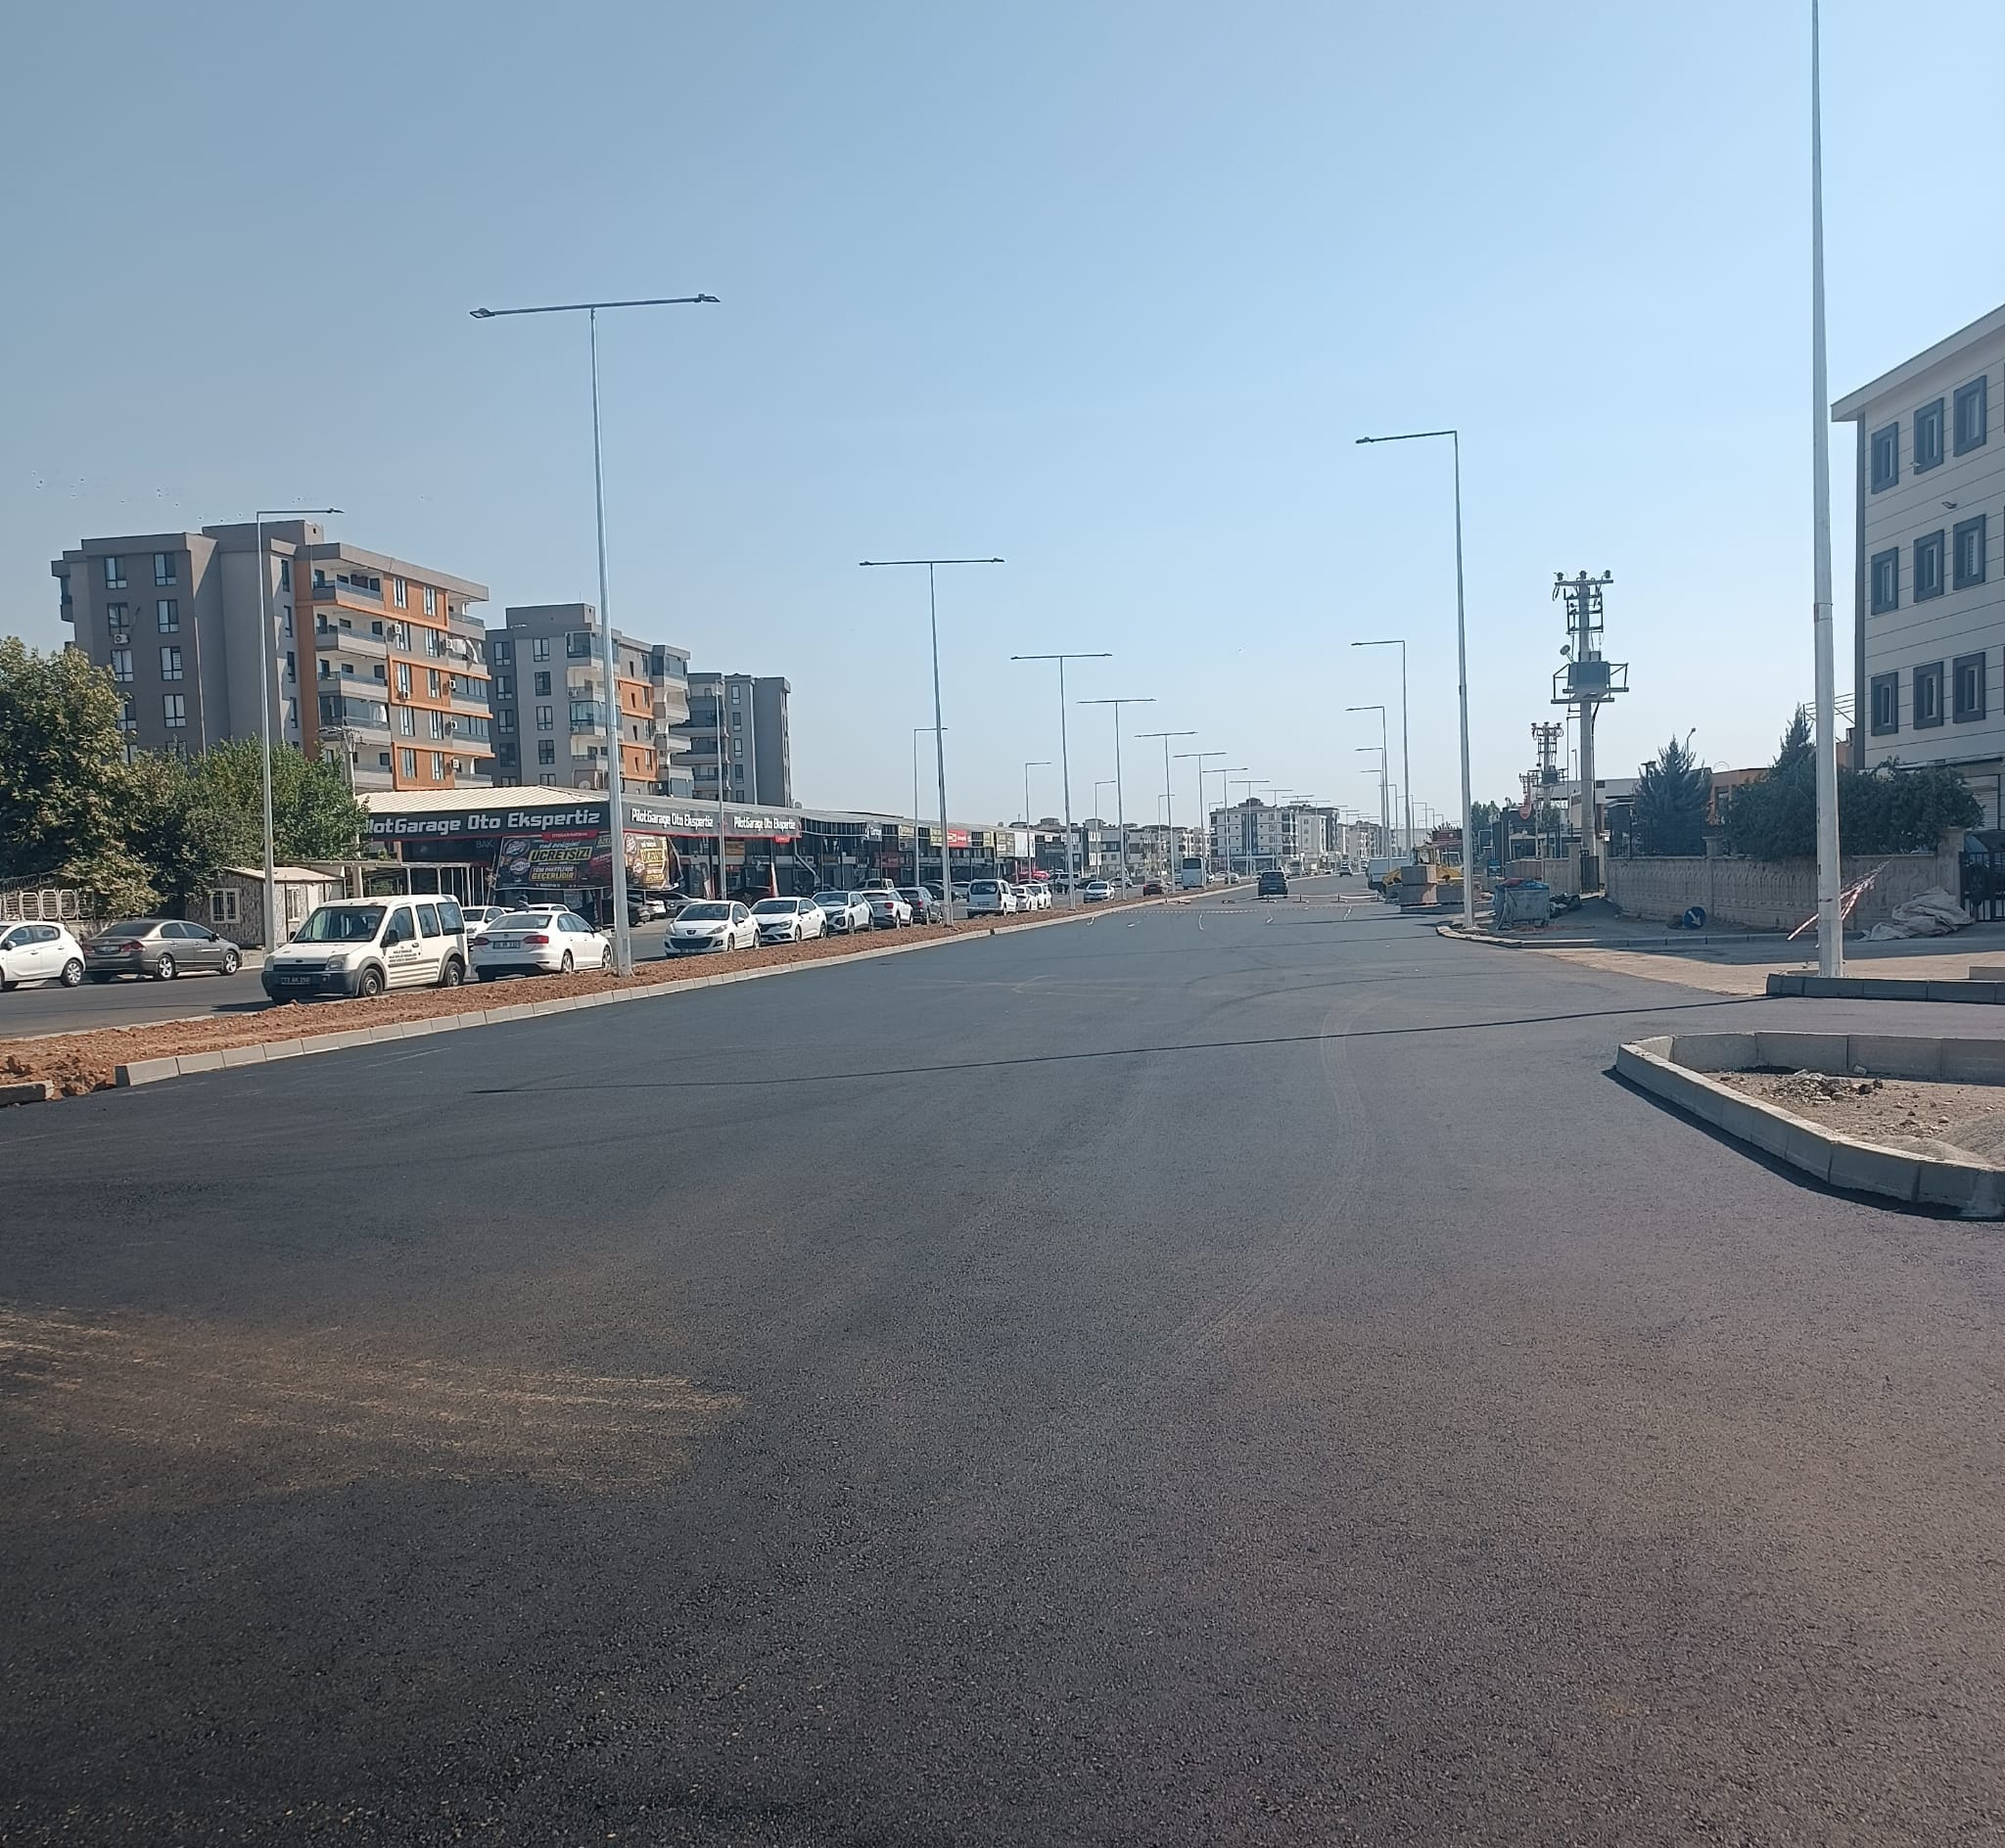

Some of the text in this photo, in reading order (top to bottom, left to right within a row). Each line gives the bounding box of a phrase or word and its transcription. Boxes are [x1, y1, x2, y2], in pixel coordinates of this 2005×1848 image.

[467, 813, 500, 830] Oto
[507, 808, 600, 830] Ekspertiz
[630, 808, 672, 828] PilotGarage
